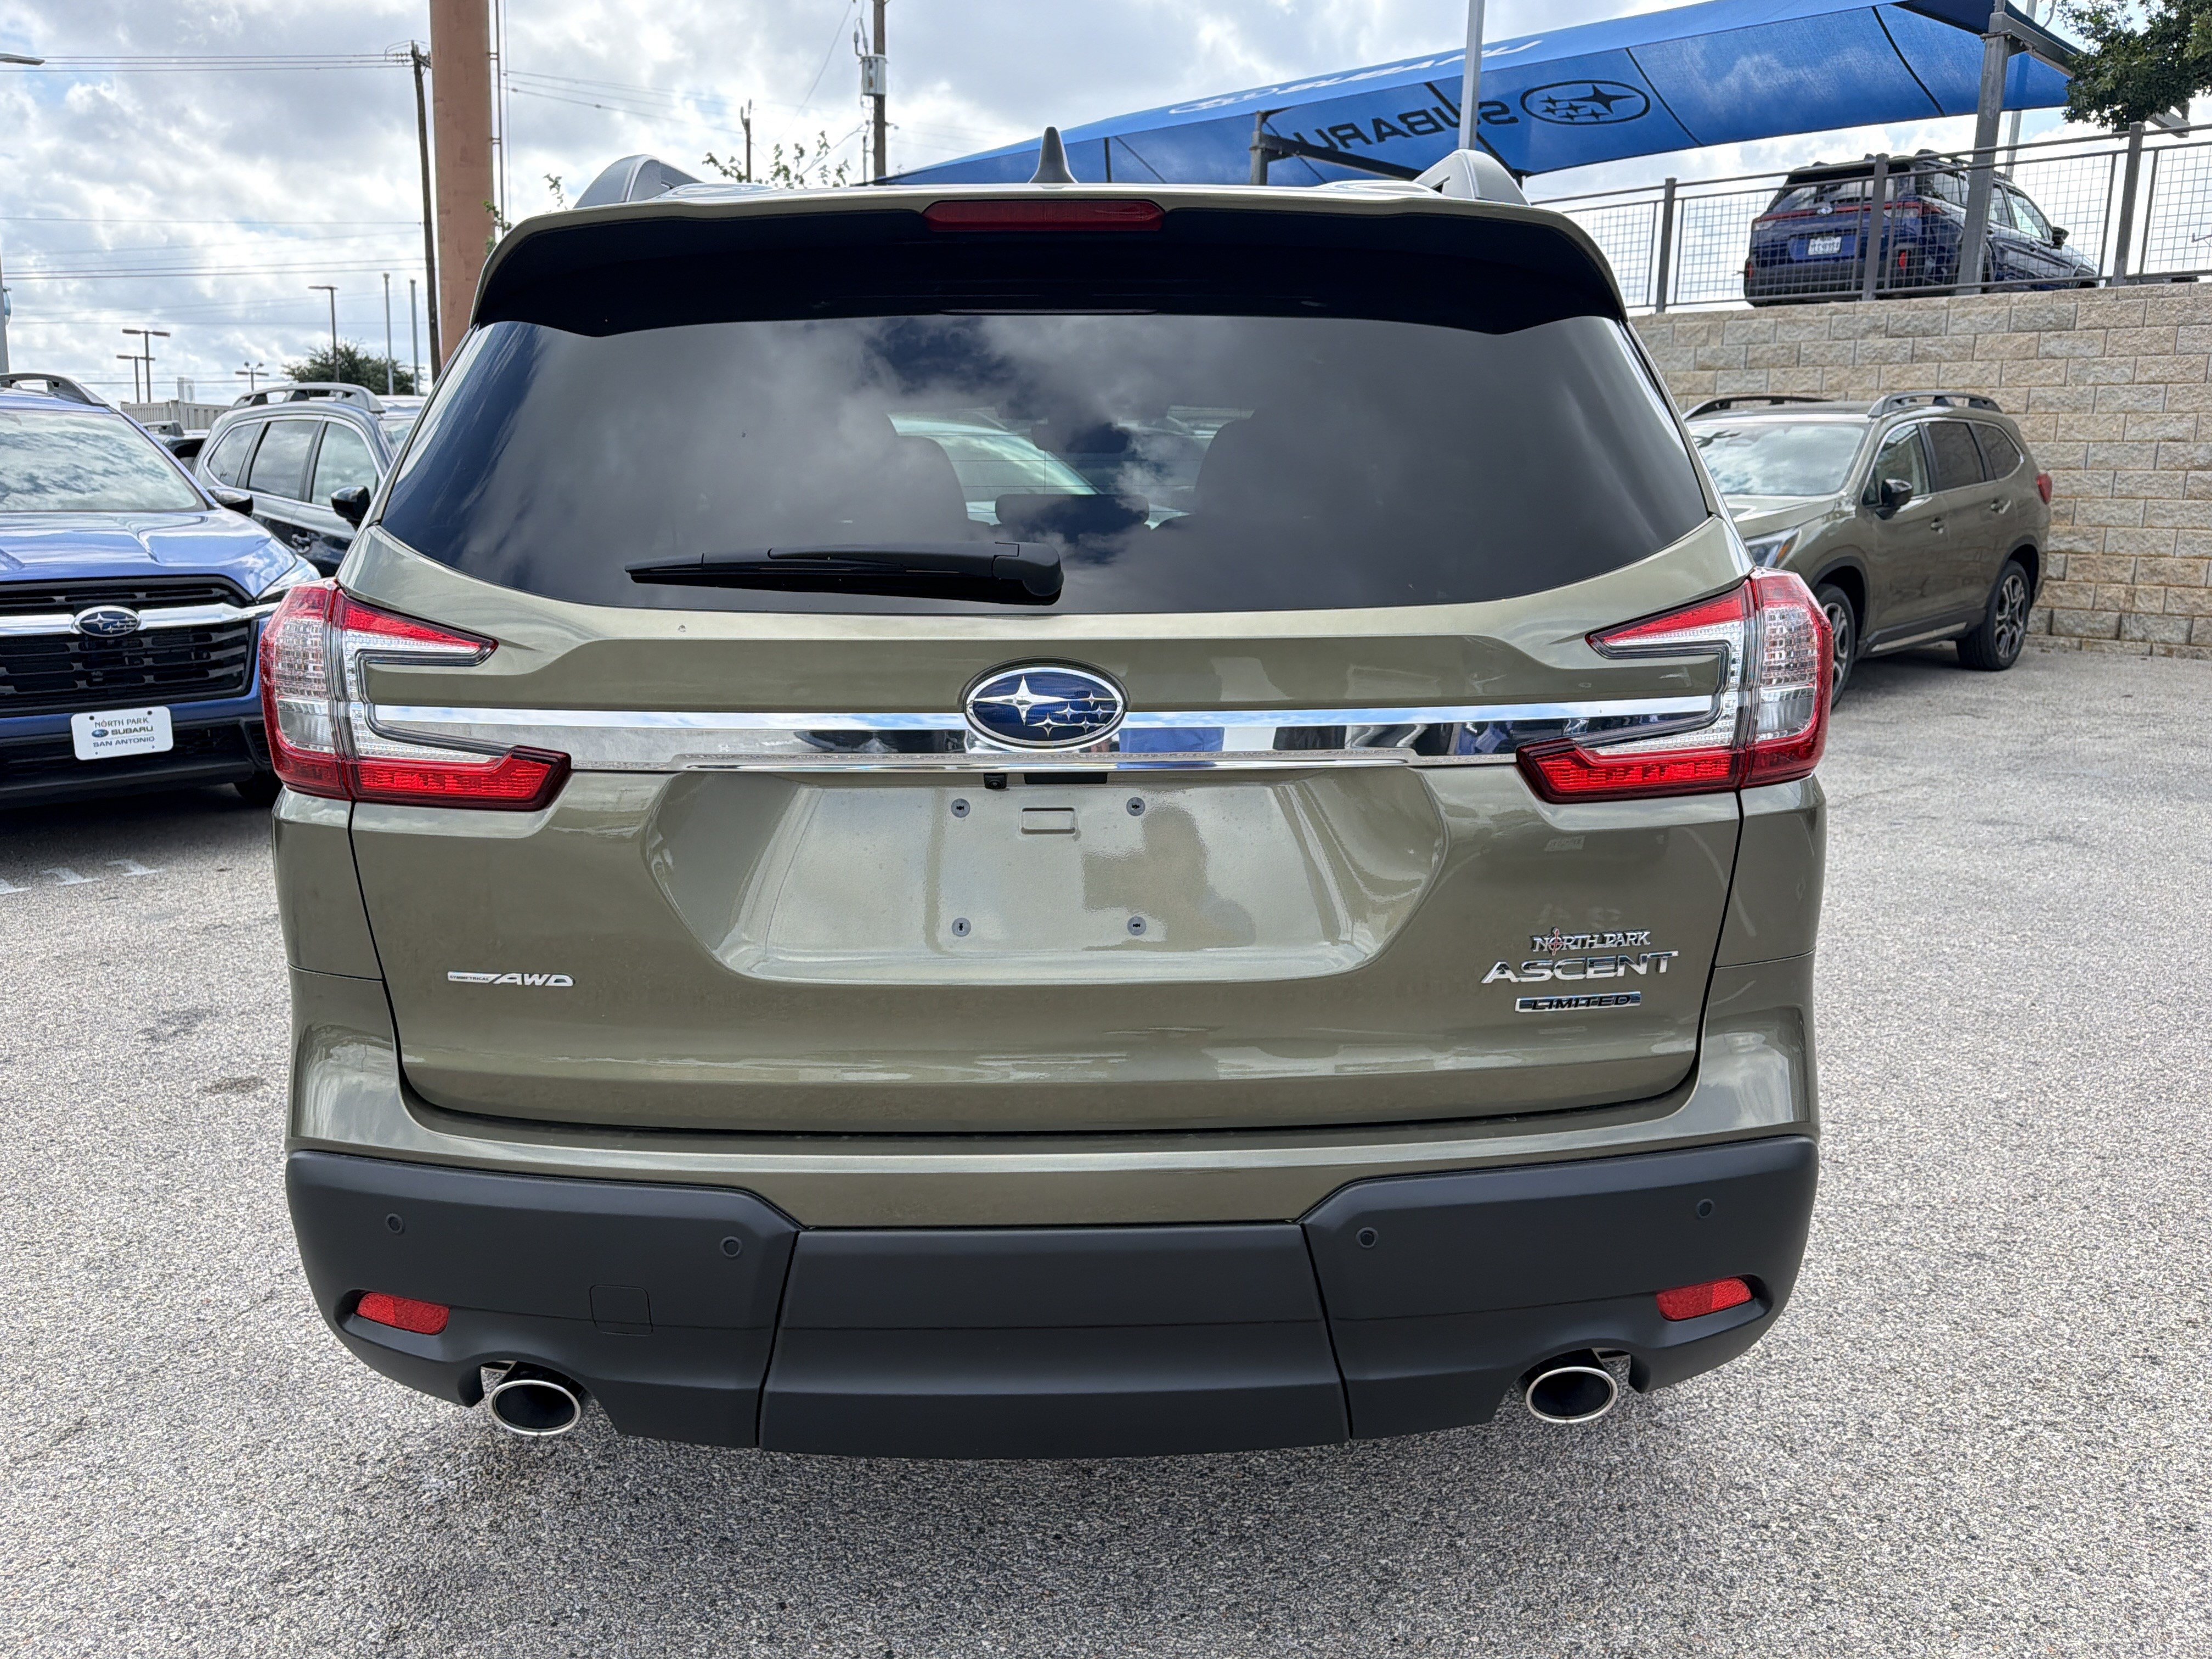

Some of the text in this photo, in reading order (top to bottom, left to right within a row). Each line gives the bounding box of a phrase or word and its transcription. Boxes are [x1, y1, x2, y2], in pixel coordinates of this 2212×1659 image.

[94, 717, 149, 729] NORTH PARK
[111, 725, 154, 735] SUBARU
[93, 736, 155, 748] SAN ANTONIO
[1531, 928, 1651, 955] NORTH PARK
[1481, 950, 1679, 984] ASCENT
[493, 973, 574, 986] AWD
[1531, 995, 1632, 1011] LIMITED
